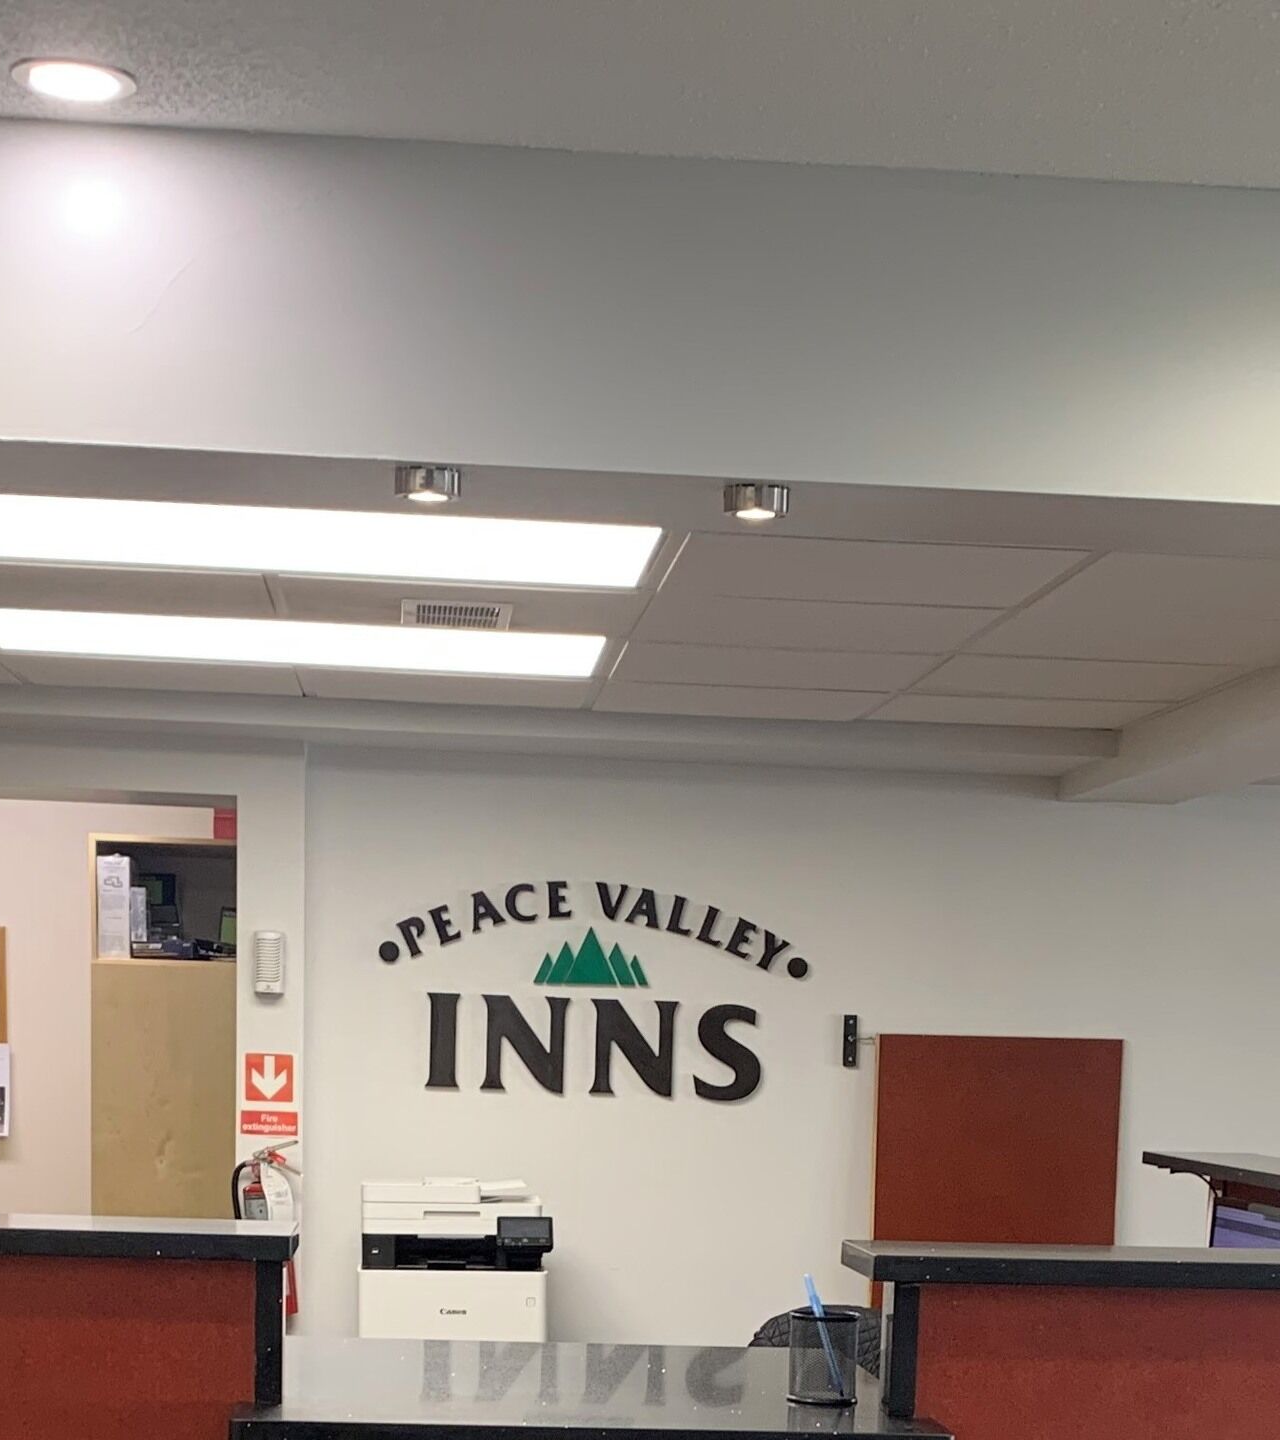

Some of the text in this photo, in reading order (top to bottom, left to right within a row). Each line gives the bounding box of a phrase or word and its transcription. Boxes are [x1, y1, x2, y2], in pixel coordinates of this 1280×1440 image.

[397, 880, 790, 971] PEACE VALLEY
[424, 992, 762, 1101] INNS
[242, 1122, 296, 1132] extinguisher
[261, 1113, 278, 1122] Fire
